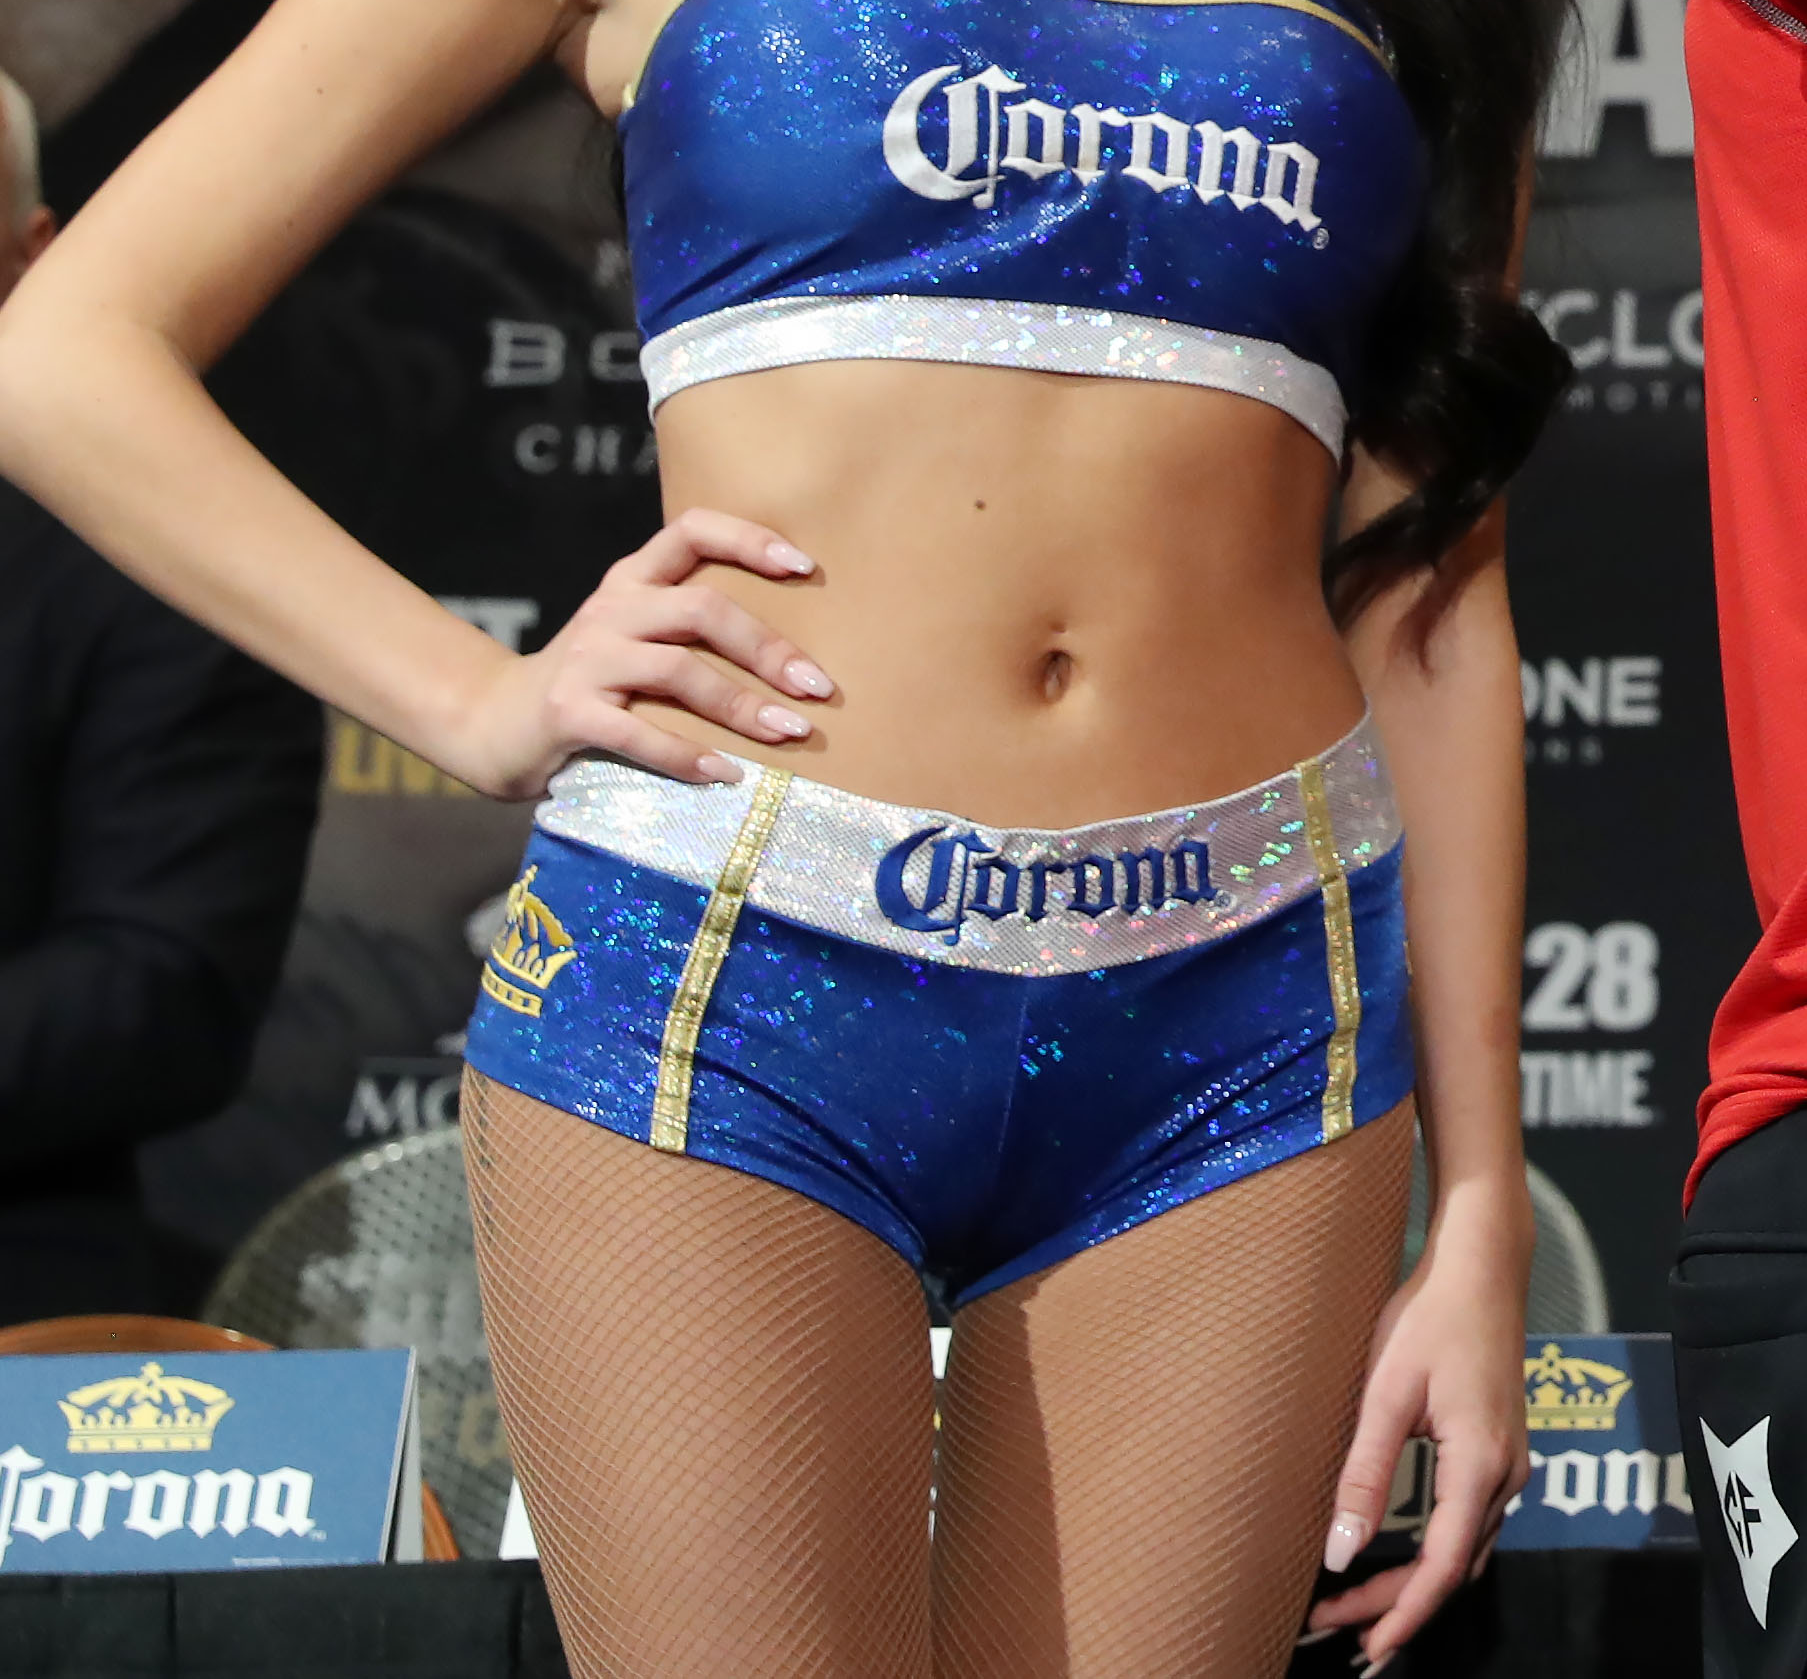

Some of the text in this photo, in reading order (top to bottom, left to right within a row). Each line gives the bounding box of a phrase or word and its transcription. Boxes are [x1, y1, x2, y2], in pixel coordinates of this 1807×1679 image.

[882, 64, 1324, 232] Corona
[874, 825, 1222, 946] Corona
[1522, 920, 1661, 1033] 28
